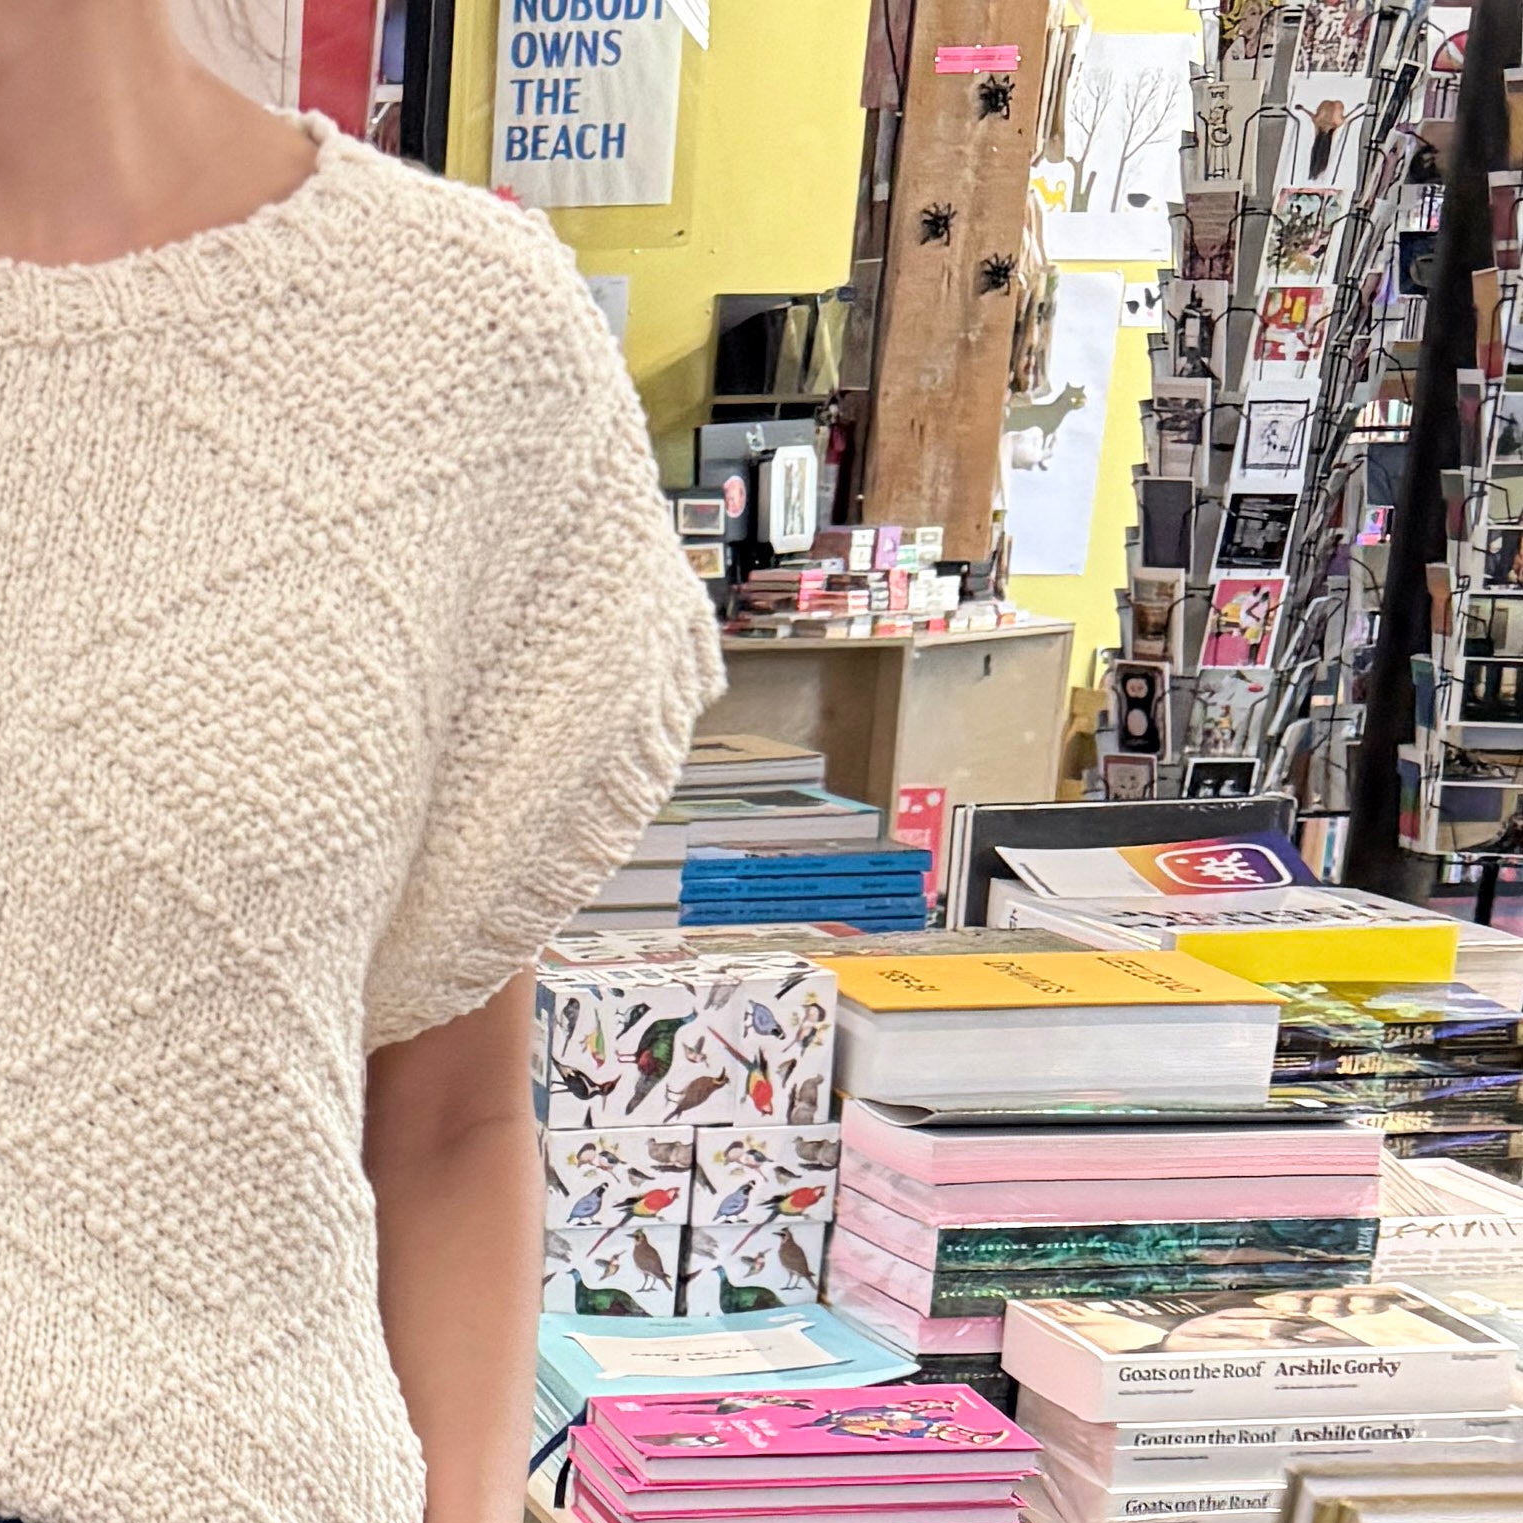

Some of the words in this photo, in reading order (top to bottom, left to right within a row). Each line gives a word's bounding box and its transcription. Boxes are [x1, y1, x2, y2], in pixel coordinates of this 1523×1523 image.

[511, 29, 623, 69] OWNS
[510, 77, 582, 116] THE
[505, 122, 627, 162] BEACH
[1119, 1364, 1167, 1383] Goats
[1168, 1368, 1192, 1381] on
[1193, 1363, 1220, 1380] the
[1223, 1361, 1266, 1378] Roof
[1275, 1358, 1342, 1377] Arshile
[1344, 1357, 1402, 1378] Gorky
[1207, 1428, 1236, 1445] the
[1238, 1427, 1277, 1444] Roof
[1291, 1425, 1356, 1443] Arshile
[1358, 1424, 1415, 1442] Gorky
[1126, 1499, 1173, 1514] Goats
[1174, 1501, 1196, 1512] on
[1198, 1495, 1227, 1512] the
[1229, 1495, 1269, 1511] Roof
